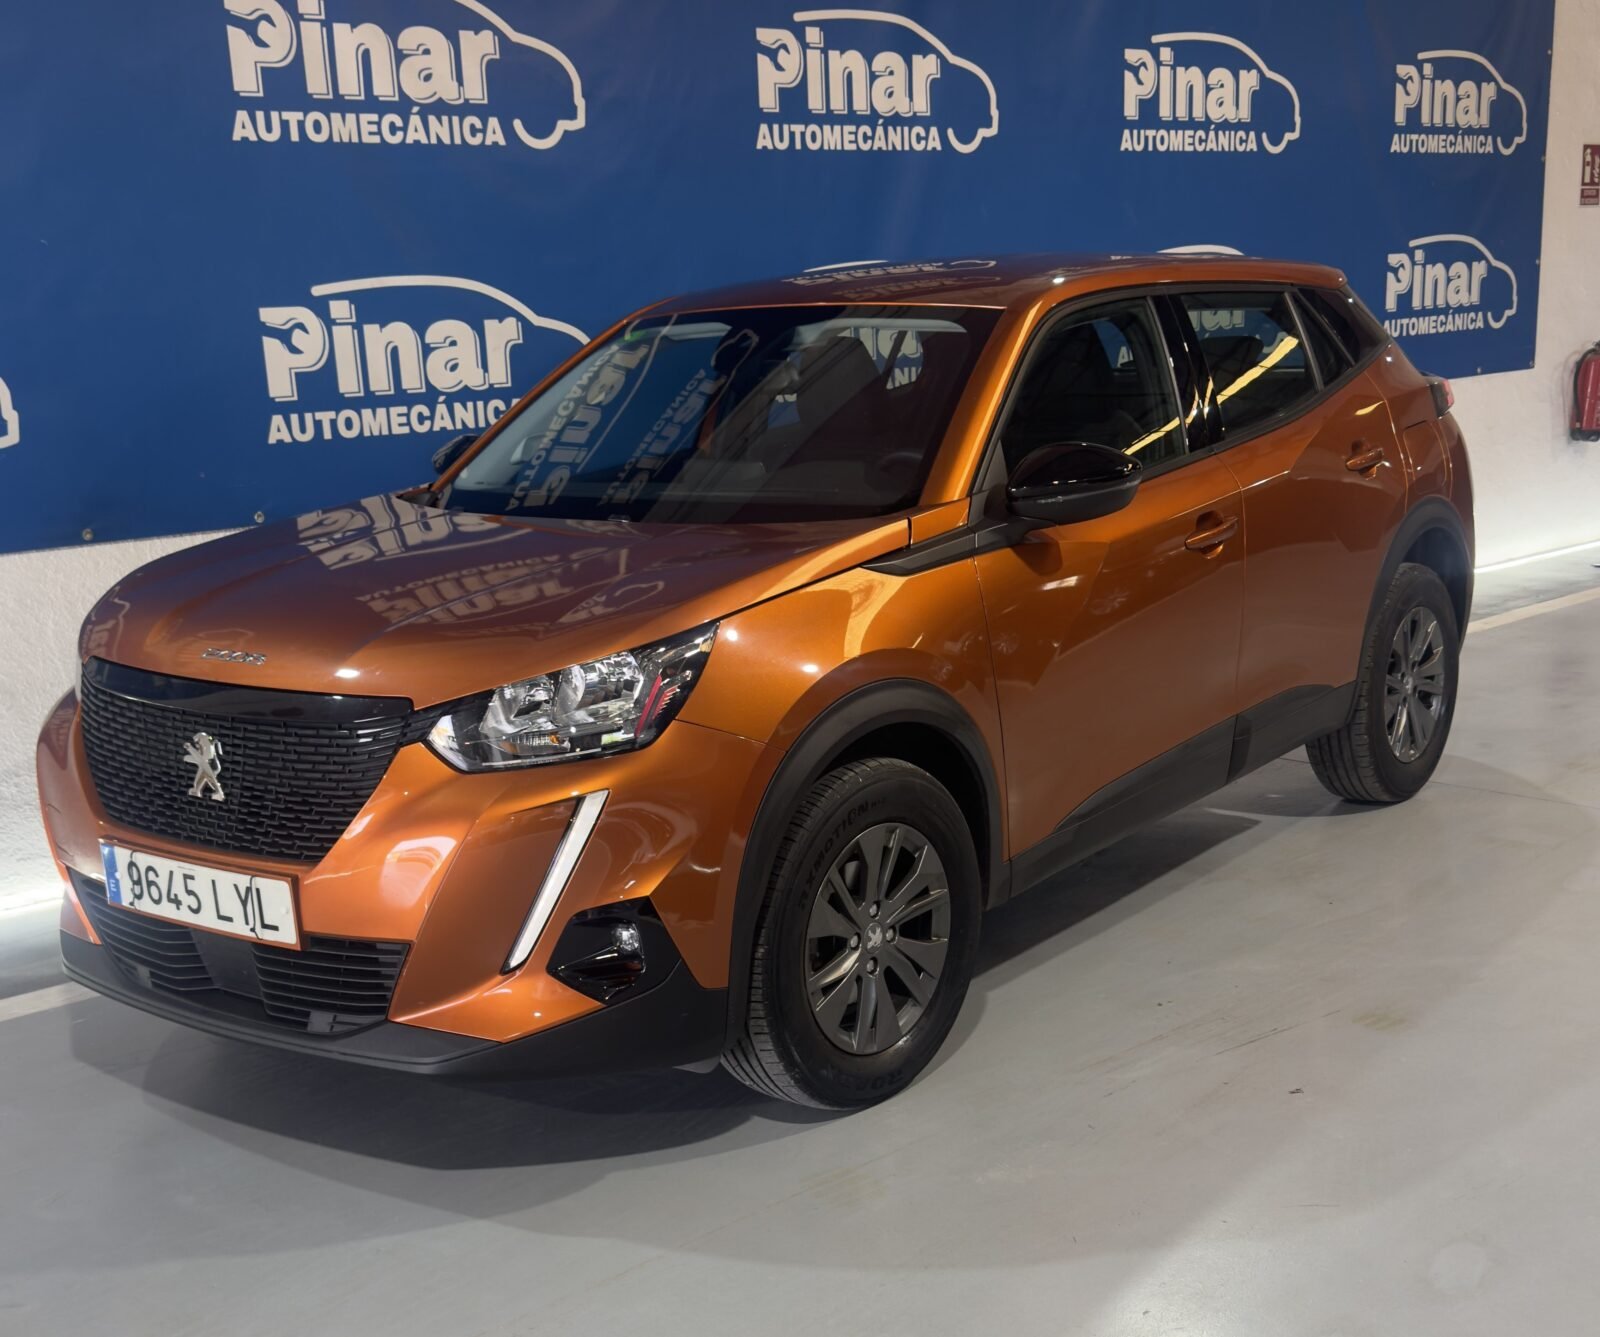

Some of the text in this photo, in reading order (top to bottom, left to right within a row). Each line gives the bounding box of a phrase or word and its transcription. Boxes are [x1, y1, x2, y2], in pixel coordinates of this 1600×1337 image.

[224, 0, 500, 104] Pinar
[755, 26, 941, 117] Pinar
[1123, 46, 1260, 122] Pinar
[1393, 63, 1497, 129] Pinar
[232, 106, 506, 147] AUTOMECÁNICA
[756, 119, 941, 152] AUTOMECÁNICA
[1120, 125, 1258, 153] AUTOMECÁNICA
[1390, 129, 1494, 155] AUTOMECÁNICA
[1385, 249, 1487, 312] Pinar
[258, 299, 523, 402] Pinar
[1383, 309, 1485, 338] AUTOMECÁNICA
[268, 396, 521, 444] AUTOMECÁNIC
[201, 647, 267, 666] 2008
[127, 860, 279, 932] 9645 LYL
